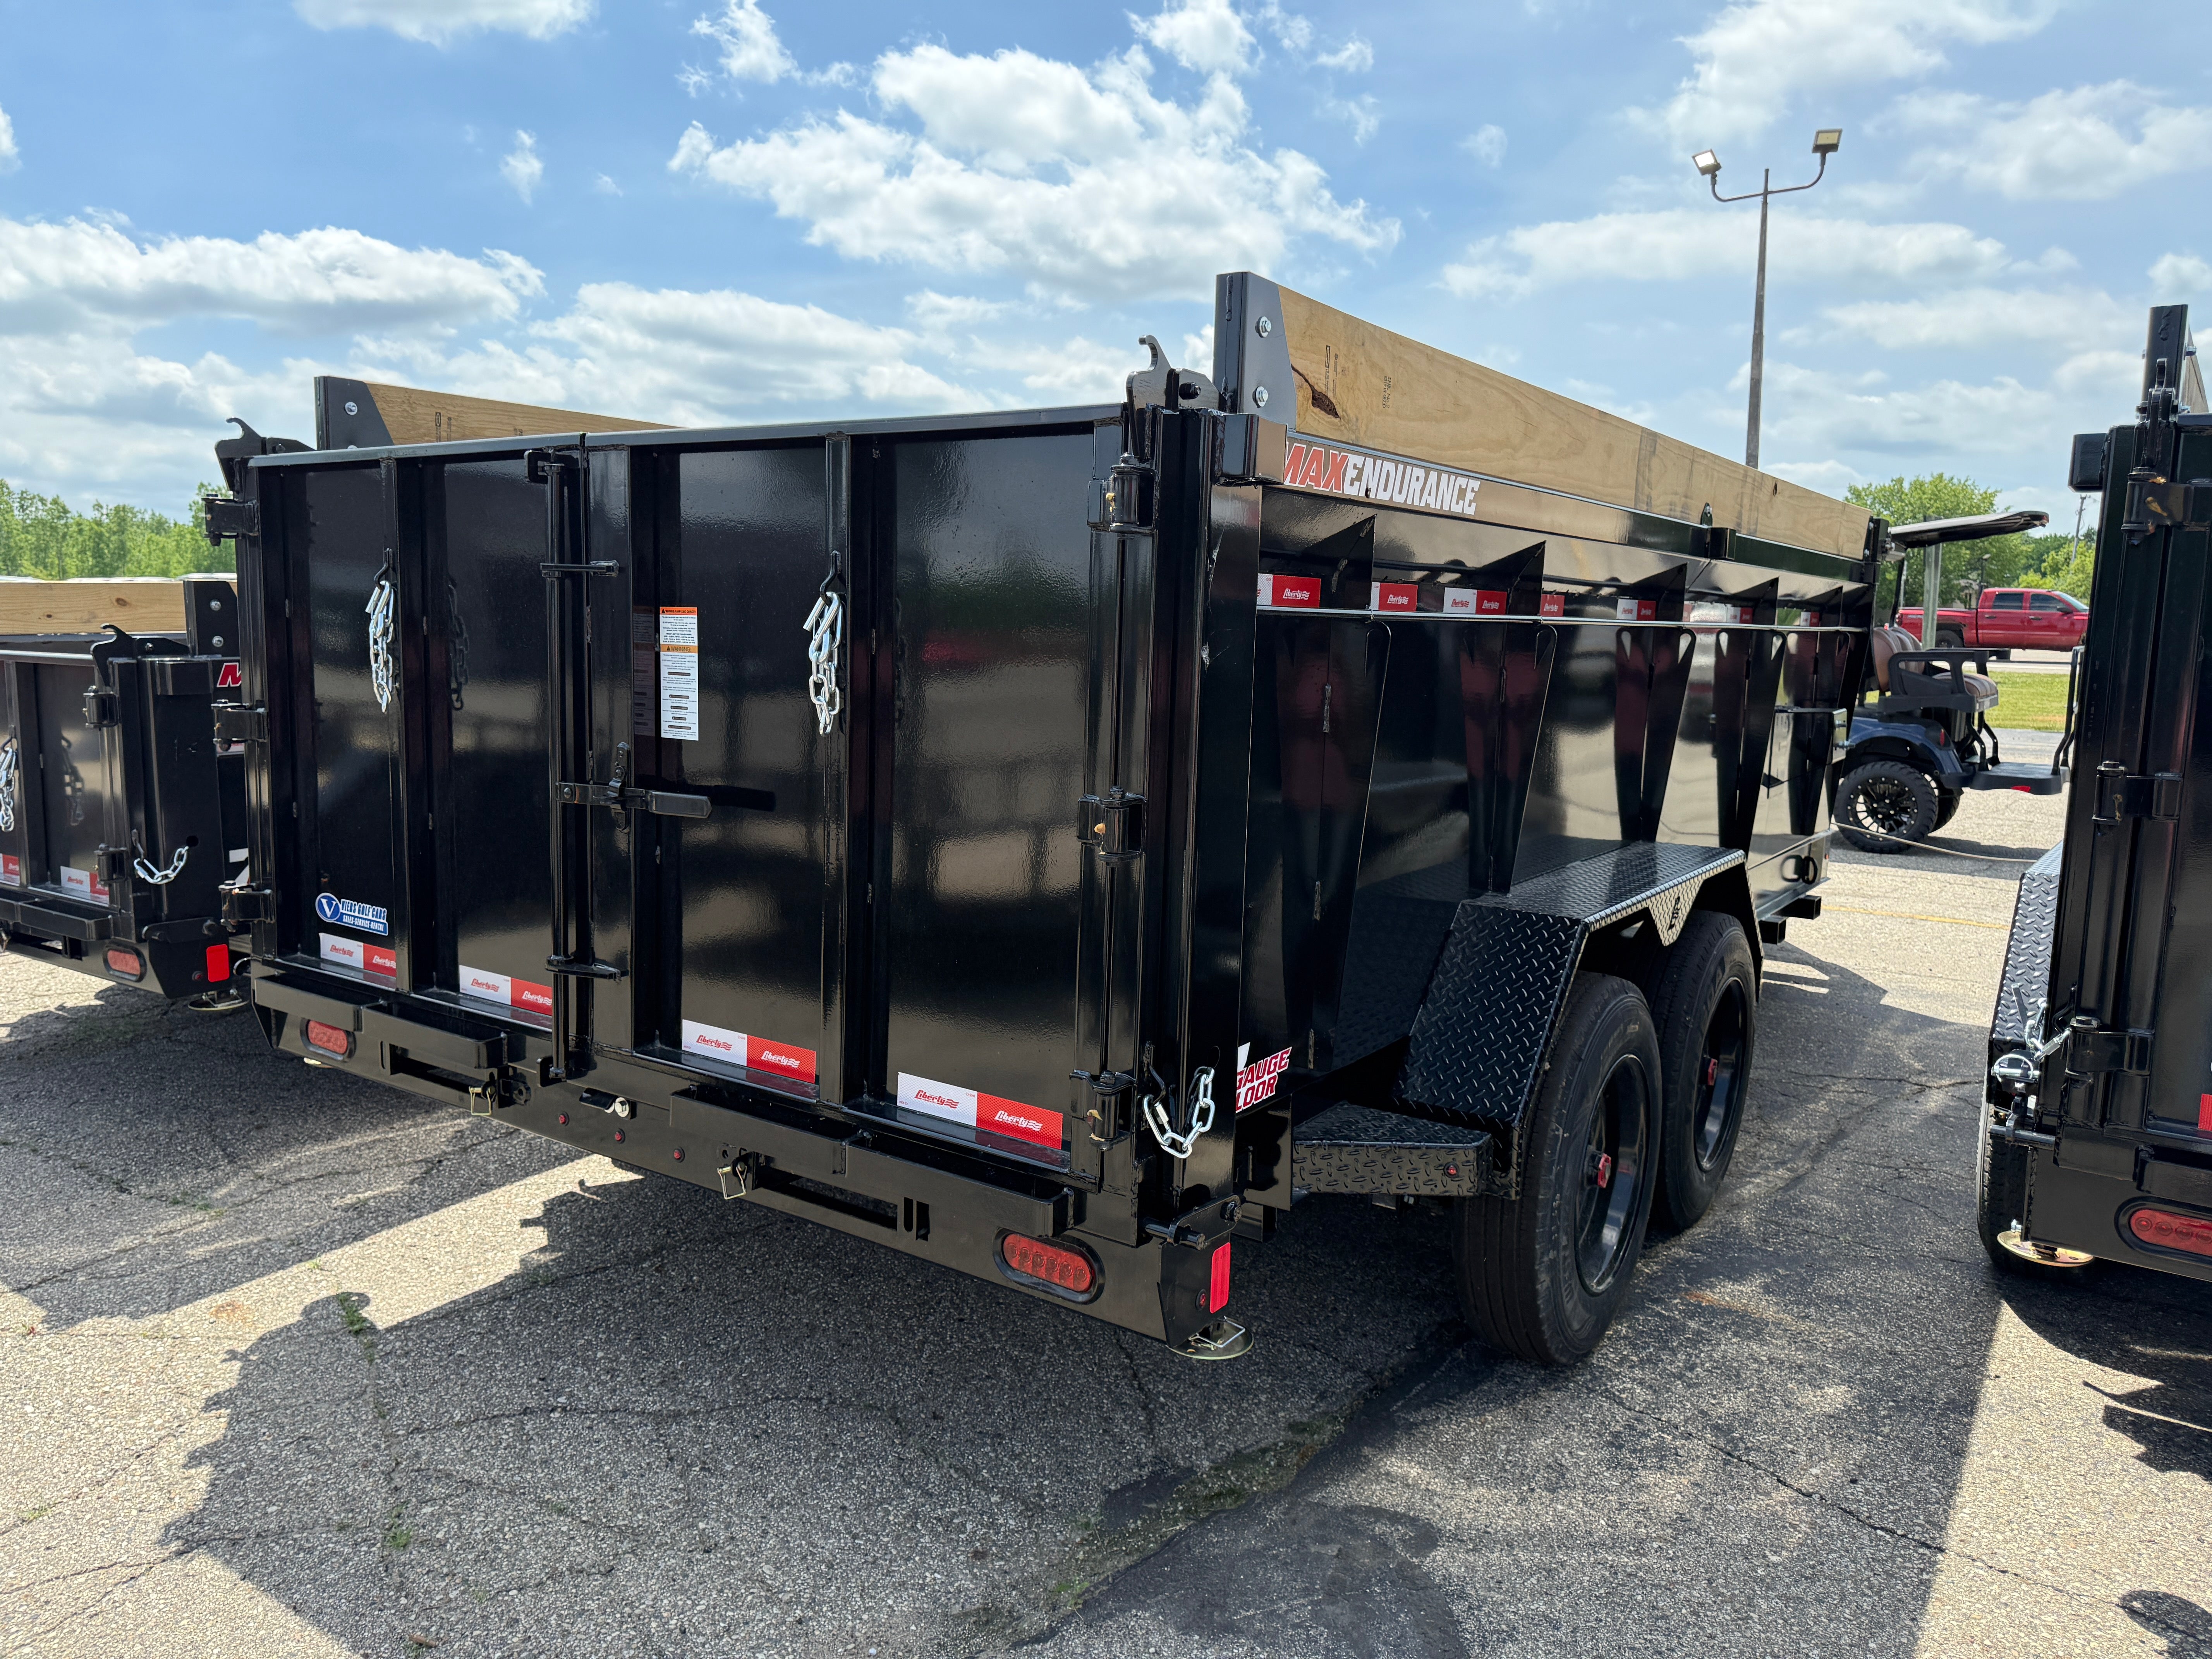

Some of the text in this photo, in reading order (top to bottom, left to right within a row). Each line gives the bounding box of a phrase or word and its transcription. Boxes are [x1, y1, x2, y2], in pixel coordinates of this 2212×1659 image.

[1282, 588, 1303, 600] Liberty
[357, 904, 372, 917] GOLF
[371, 907, 386, 921] CARS
[471, 978, 544, 1003] Liberty Liberty
[696, 1034, 789, 1064] Liberty Liberty
[1237, 1047, 1292, 1090] GAUGE
[914, 1089, 1029, 1127] Liberty Liberty
[1236, 1074, 1278, 1113] LOOR
